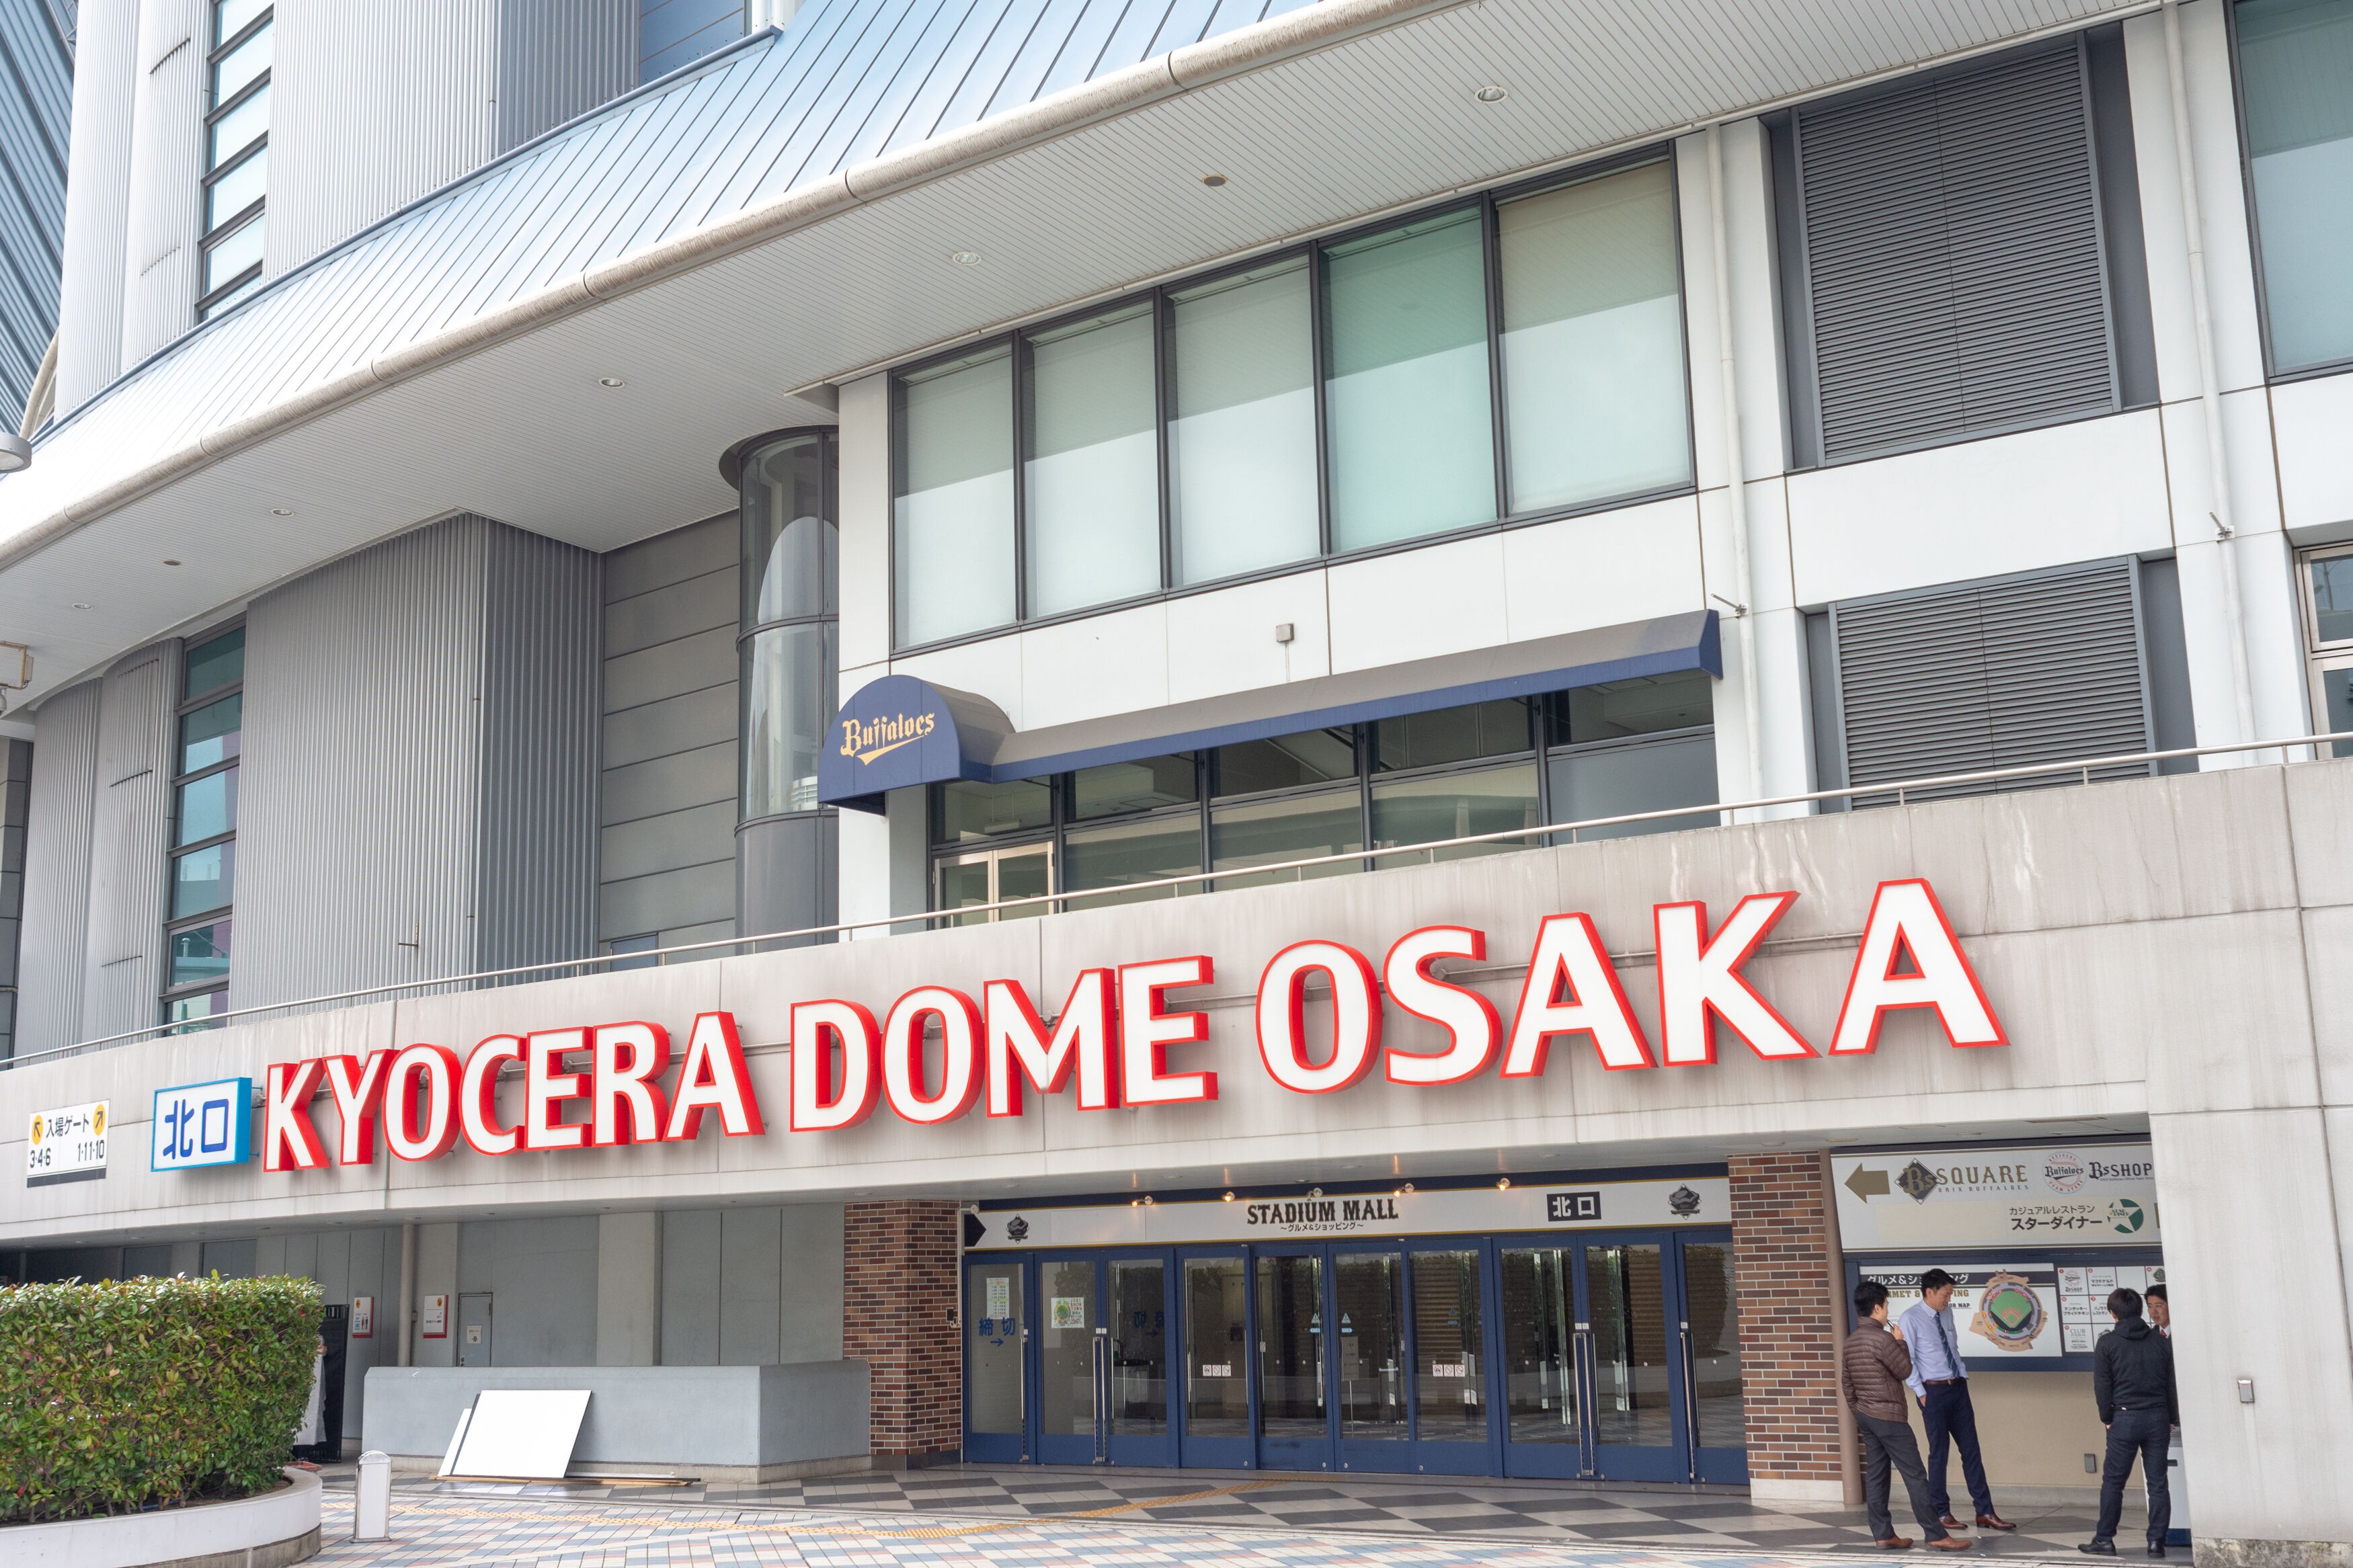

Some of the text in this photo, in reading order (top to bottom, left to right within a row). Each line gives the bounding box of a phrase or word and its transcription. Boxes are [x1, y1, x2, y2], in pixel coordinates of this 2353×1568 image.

[840, 712, 935, 757] Buffaloes
[264, 878, 2011, 1172] KYOCERA DOME OSAKA
[46, 1113, 90, 1139] 入場ゲート
[162, 1098, 230, 1160] 北口
[1936, 1165, 2028, 1185] SQUARE
[2044, 1165, 2084, 1178] Buffaloes
[1968, 1184, 2029, 1192] BUFFALOES
[1246, 1198, 1399, 1225] STADIUM MALL
[1552, 1196, 1595, 1217] 北口
[2009, 1205, 2096, 1215] カジュアルレストラン
[2011, 1216, 2103, 1231] スターダイナー
[978, 1317, 1016, 1337] 締切
